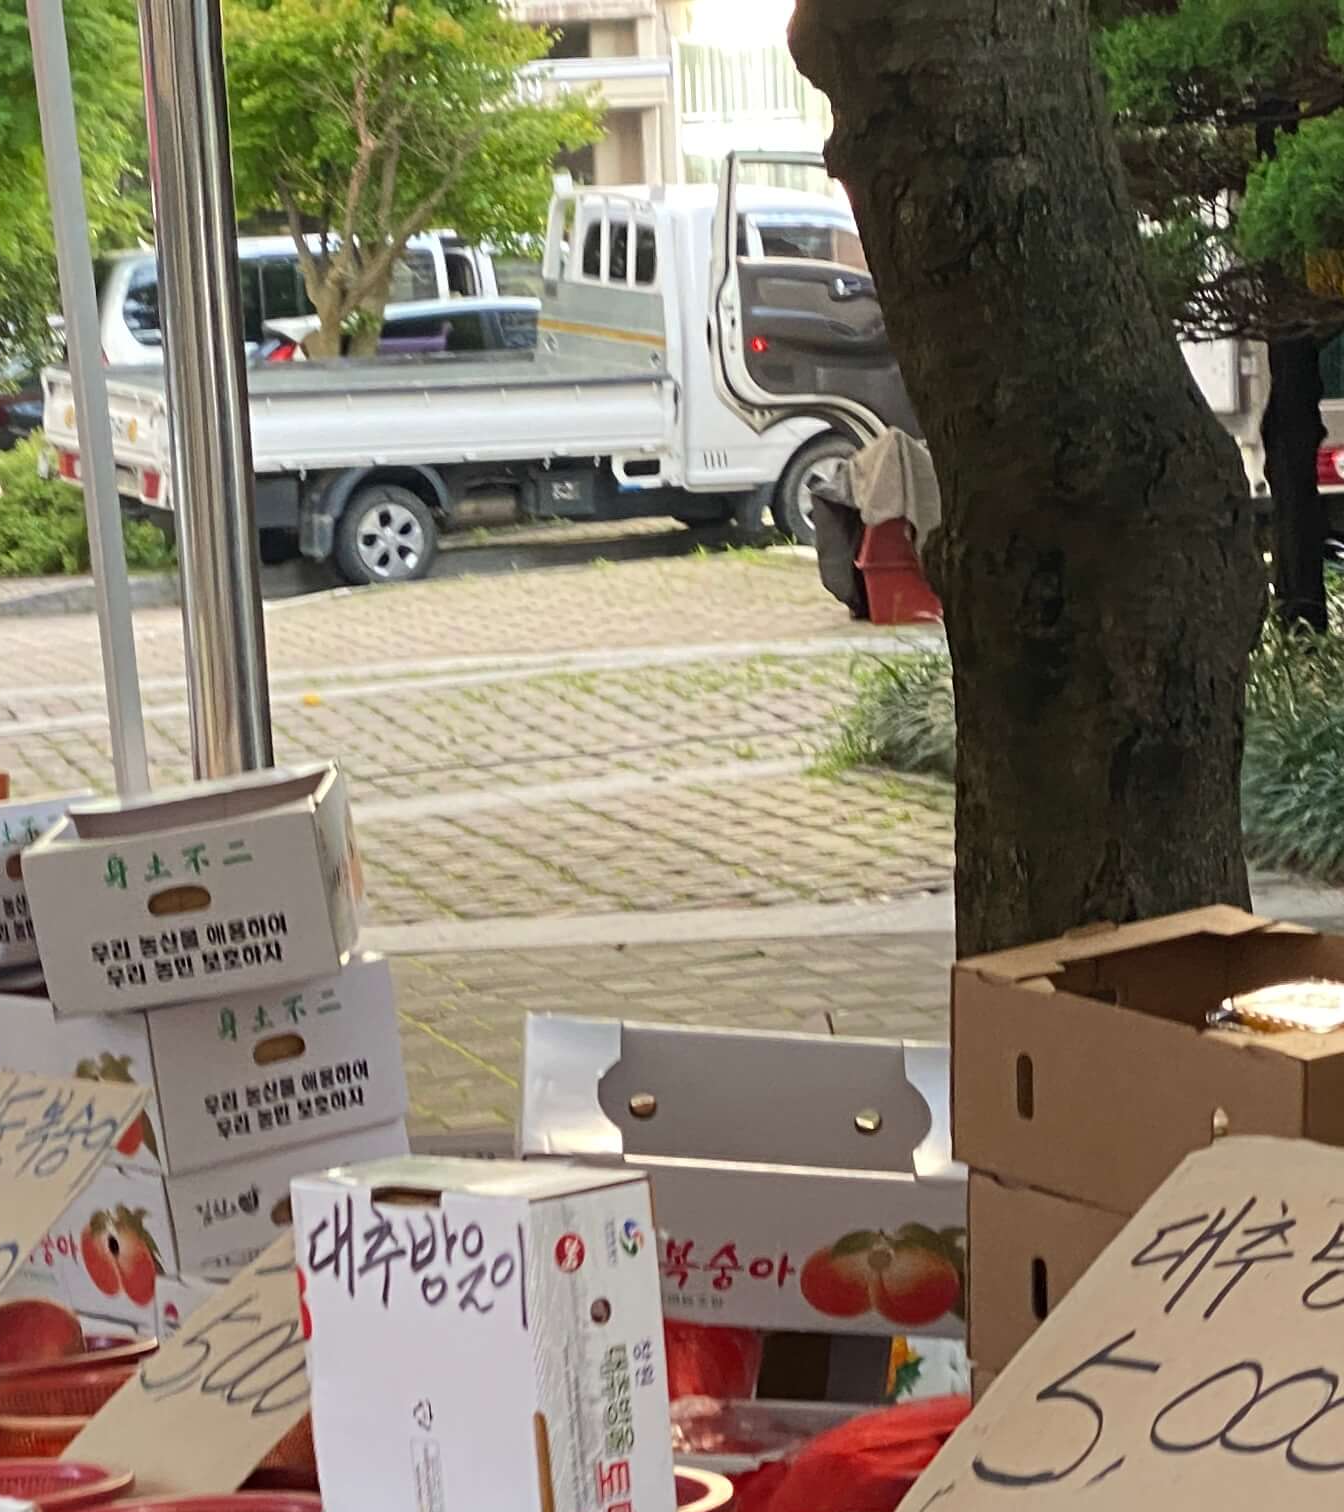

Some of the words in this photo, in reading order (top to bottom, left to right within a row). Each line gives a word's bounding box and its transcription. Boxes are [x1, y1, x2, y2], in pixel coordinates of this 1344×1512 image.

[104, 839, 254, 890] 身土不二
[90, 938, 131, 966] 우리
[139, 926, 199, 959] 농산물
[206, 911, 288, 946] 애용하여
[106, 962, 147, 989] 우리
[155, 955, 195, 983] 농민
[202, 940, 283, 974] 보호하자
[218, 988, 343, 1043] 身土不二
[204, 1088, 239, 1117] 우리
[245, 1075, 295, 1108] 농산물
[301, 1058, 369, 1091] 애용하여
[216, 1112, 251, 1140] 우리
[257, 1103, 291, 1131] 농민
[297, 1085, 364, 1121] 보호하자
[29, 1232, 79, 1266] 숭아
[661, 1239, 796, 1290] 복숭아
[1129, 1195, 1296, 1322] 대추
